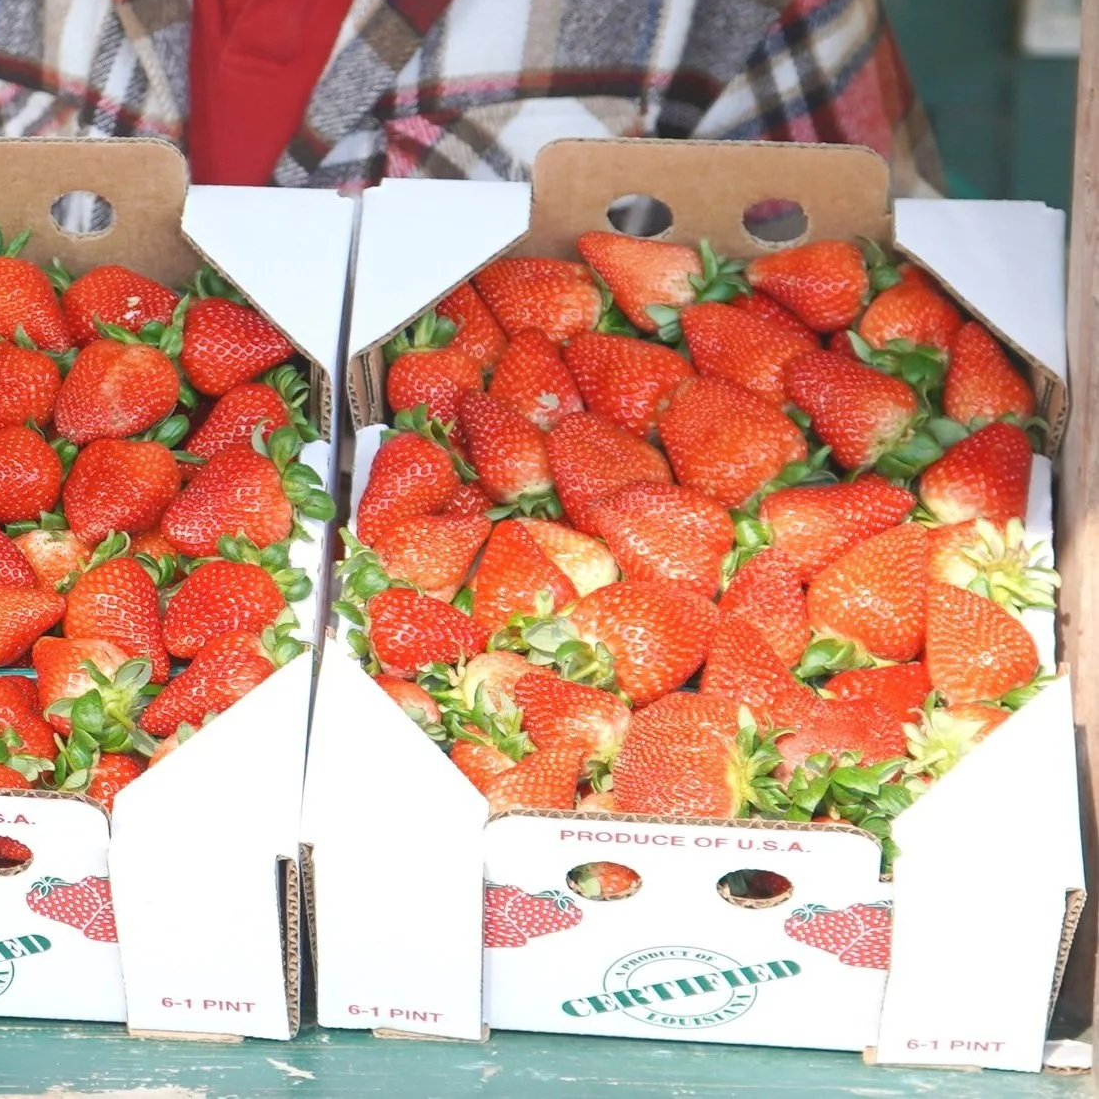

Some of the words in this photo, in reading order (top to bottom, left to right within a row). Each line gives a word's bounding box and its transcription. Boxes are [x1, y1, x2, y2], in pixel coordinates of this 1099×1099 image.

[559, 829, 686, 847] PRODUCE
[694, 836, 729, 849] OF
[737, 839, 812, 853] U.S.A.
[614, 970, 627, 978] A
[621, 950, 691, 971] PRODUCT
[694, 952, 718, 962] OF
[560, 959, 802, 1018] CERTIFIED
[161, 997, 192, 1009] 6-1
[202, 999, 257, 1013] PINT
[348, 1004, 379, 1018] 6-1
[389, 1008, 445, 1023] PINT
[645, 994, 752, 1026] LOUISIANA
[906, 1038, 939, 1050] 6-1
[949, 1040, 1006, 1052] PINT
